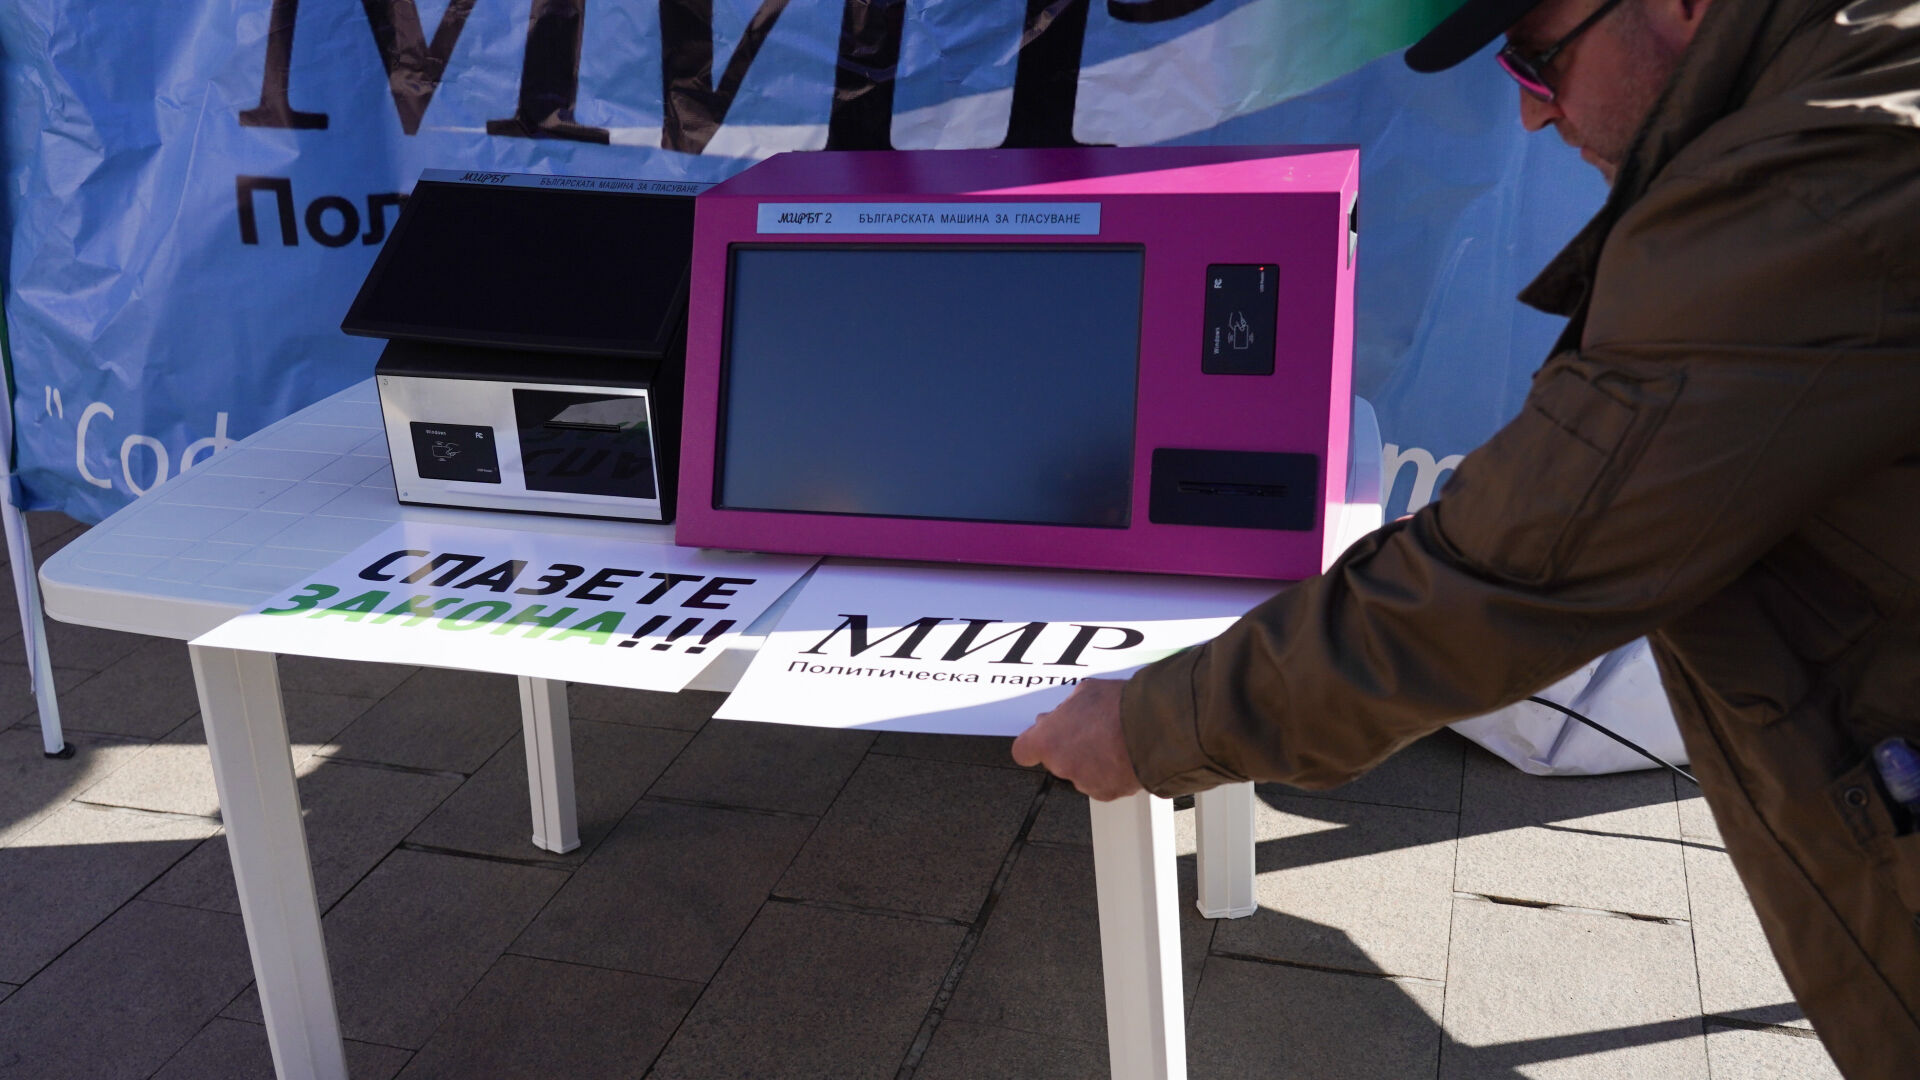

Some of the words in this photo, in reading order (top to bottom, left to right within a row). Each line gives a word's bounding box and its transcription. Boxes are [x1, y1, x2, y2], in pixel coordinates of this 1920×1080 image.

[239, 0, 1215, 154] МИ
[540, 177, 596, 189] БЪЛГАРСКАТА
[598, 181, 634, 191] МАШИНА
[636, 182, 648, 191] ЗА
[651, 183, 699, 193] ГЛАСУВАНЕ
[825, 212, 833, 224] 2
[858, 213, 936, 224] БЪЛГАРСКАТА
[940, 213, 990, 224] МАШИНА
[995, 213, 1009, 224] ЗА
[1015, 213, 1081, 225] ГЛАСУВАНЕ
[357, 549, 757, 609] СПАЗЕТЕ
[259, 583, 737, 654] ЗАКОНА!!!
[798, 613, 1145, 667] МИР
[787, 660, 979, 684] Политическа
